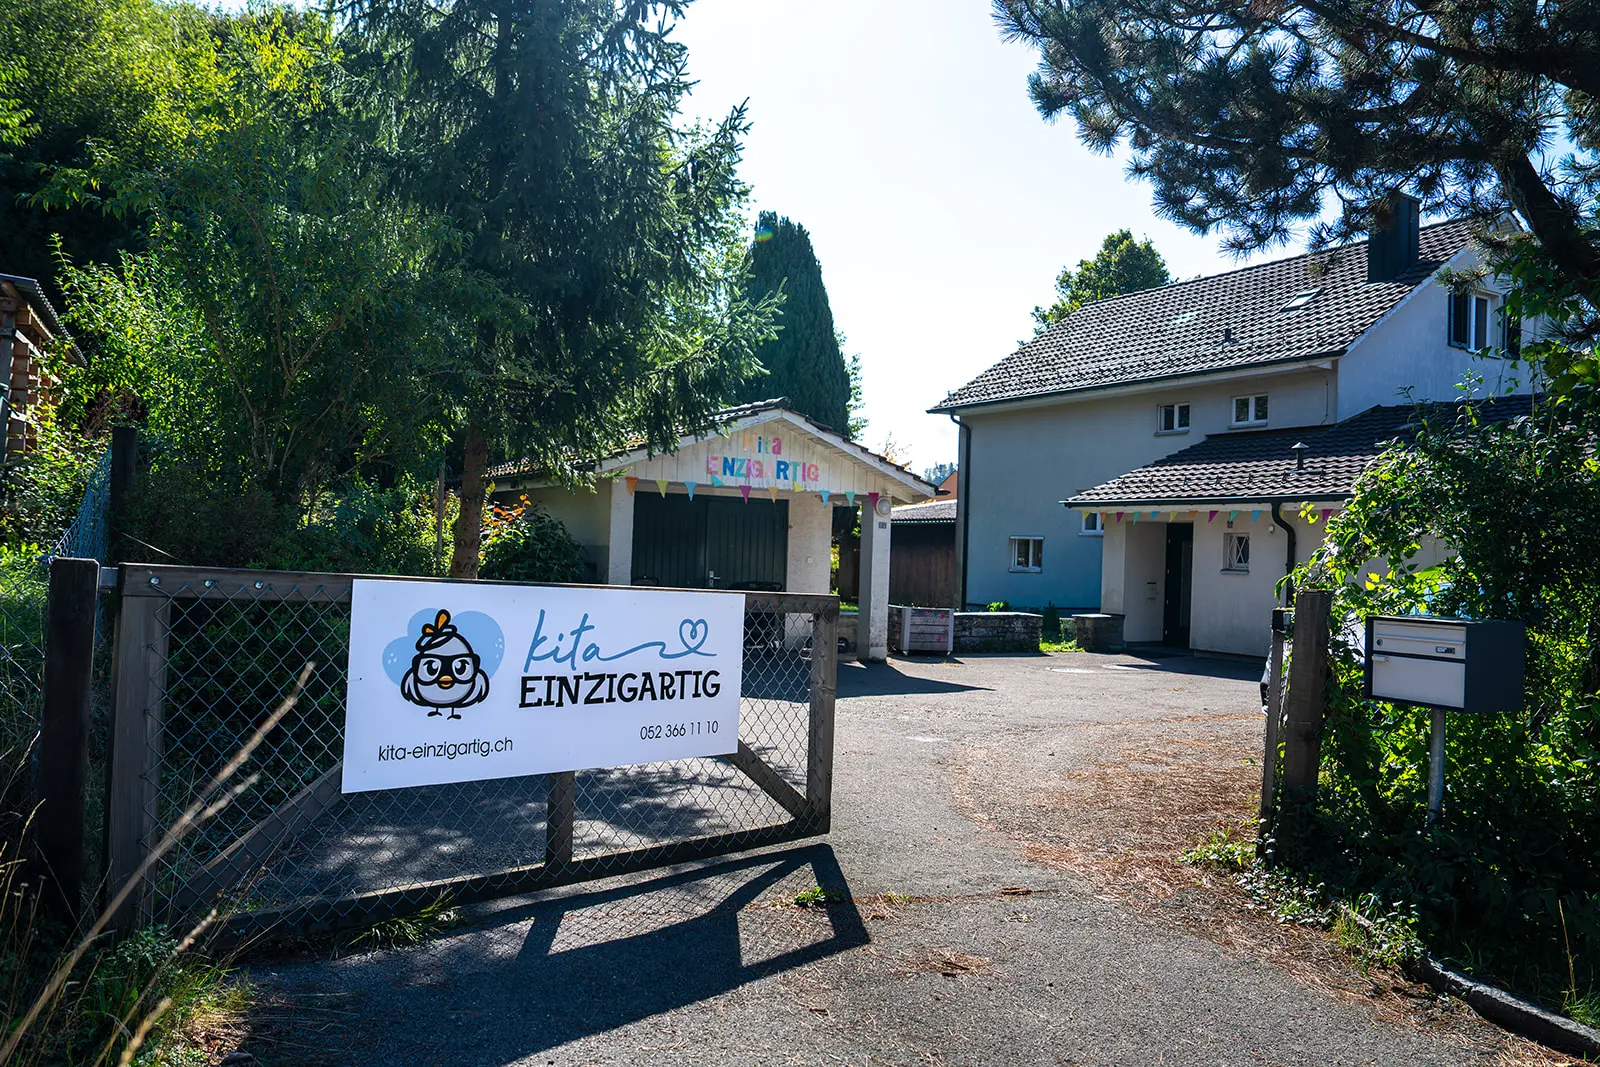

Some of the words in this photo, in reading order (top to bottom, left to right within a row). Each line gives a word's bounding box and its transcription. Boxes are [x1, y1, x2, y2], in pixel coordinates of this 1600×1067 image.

[742, 431, 782, 455] Kita
[523, 608, 604, 673] kita
[518, 669, 721, 709] EINZIGARTIG
[640, 725, 662, 740] 052
[665, 723, 686, 738] 366
[690, 721, 701, 735] 11
[707, 720, 719, 734] 10
[378, 736, 513, 762] kita-einzigartig.ch
